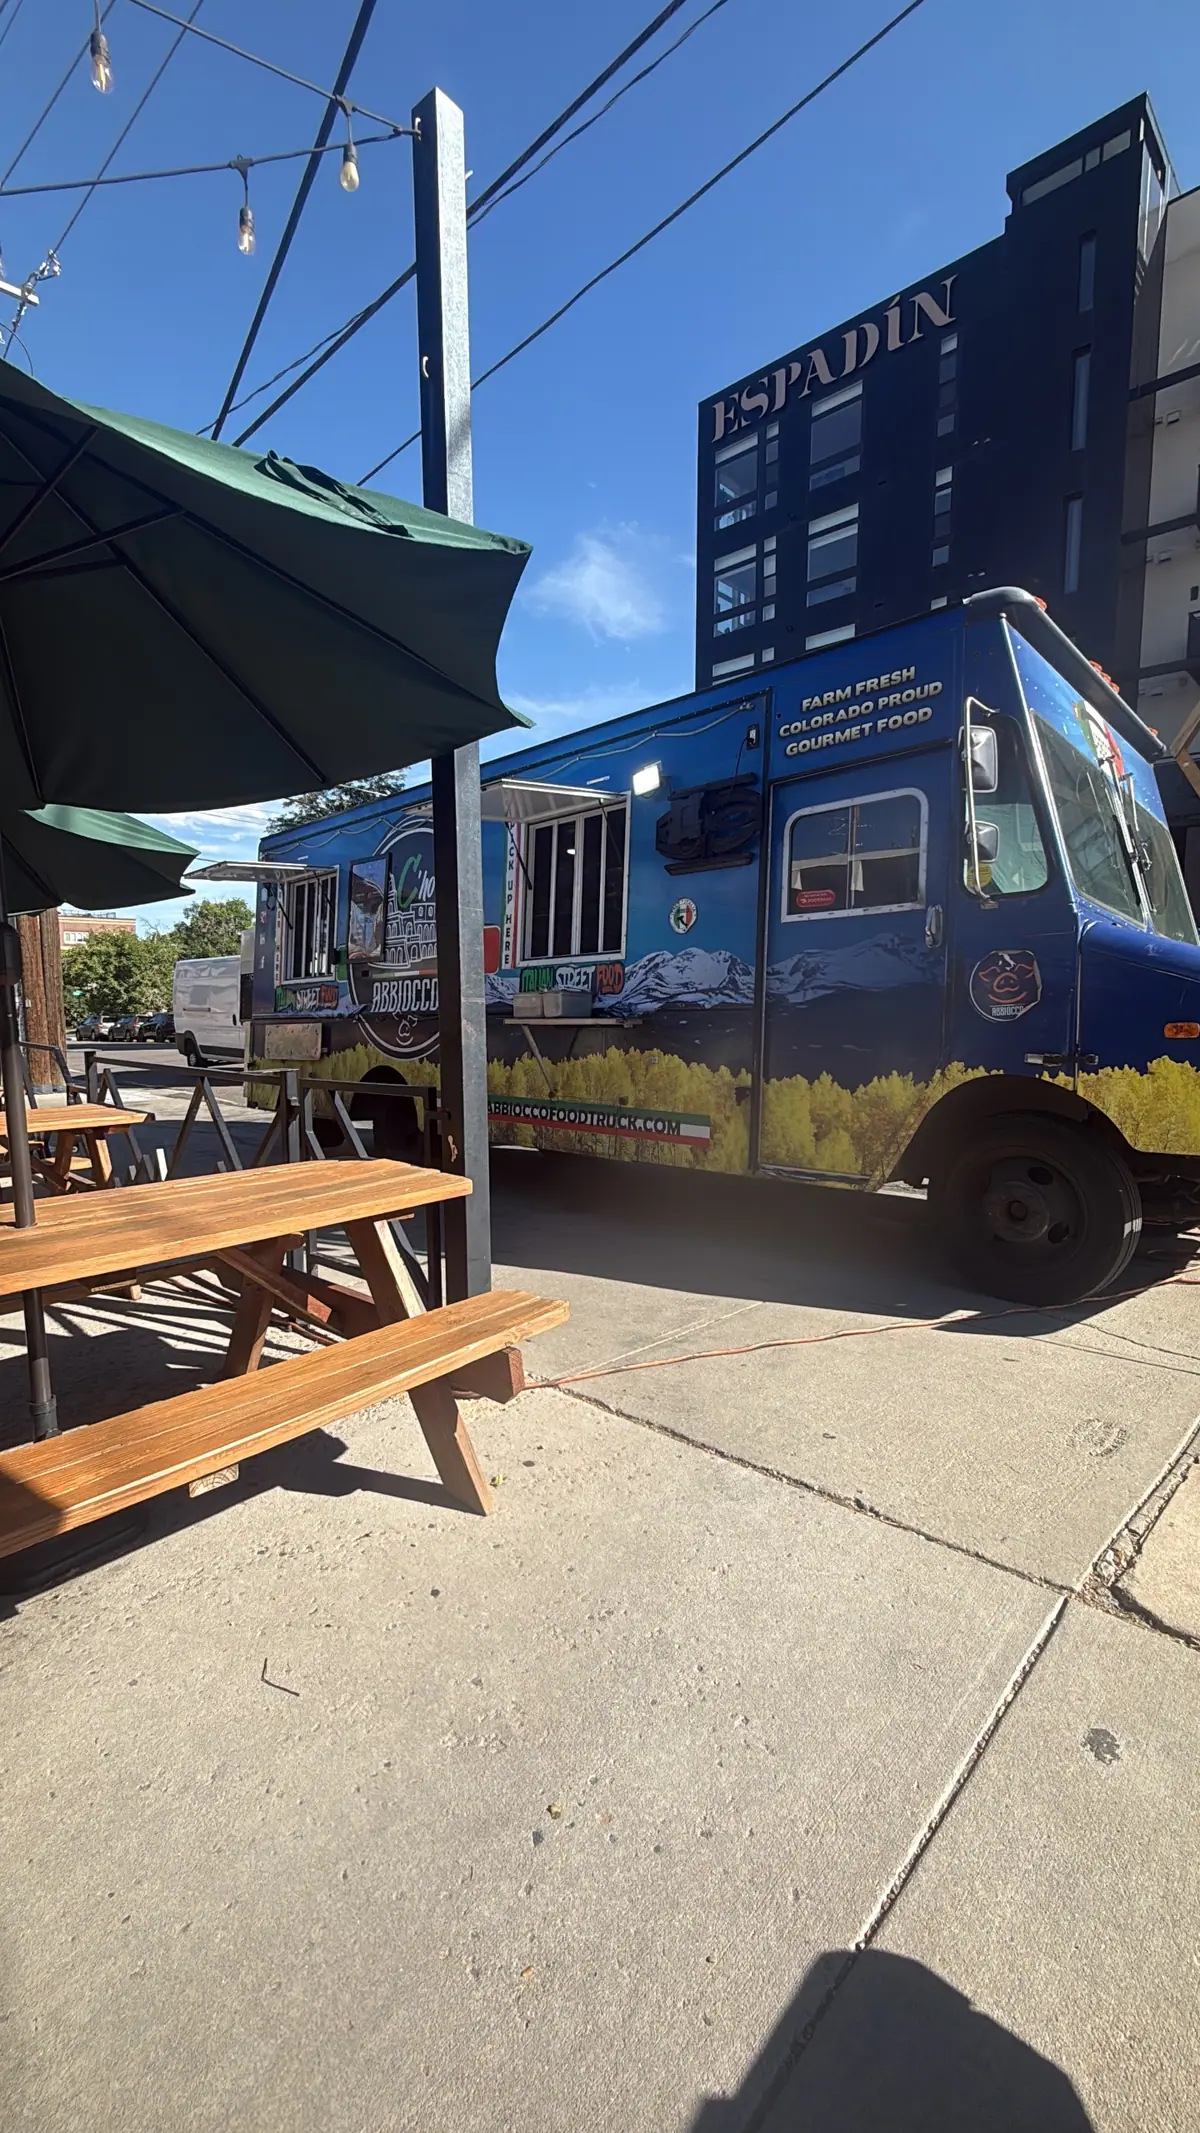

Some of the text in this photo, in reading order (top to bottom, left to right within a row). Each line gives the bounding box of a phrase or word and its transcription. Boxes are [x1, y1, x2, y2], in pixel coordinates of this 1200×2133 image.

[711, 273, 959, 443] ESPADÍN
[779, 681, 943, 737] COLORADO PROUD
[801, 666, 916, 712] FARM FRESH
[785, 707, 933, 756] GOURMET FOOD
[507, 880, 514, 904] UP
[504, 914, 512, 965] HERE
[370, 978, 439, 1012] ABBIOCCO
[555, 964, 596, 992] STREET
[596, 963, 623, 994] FOOD
